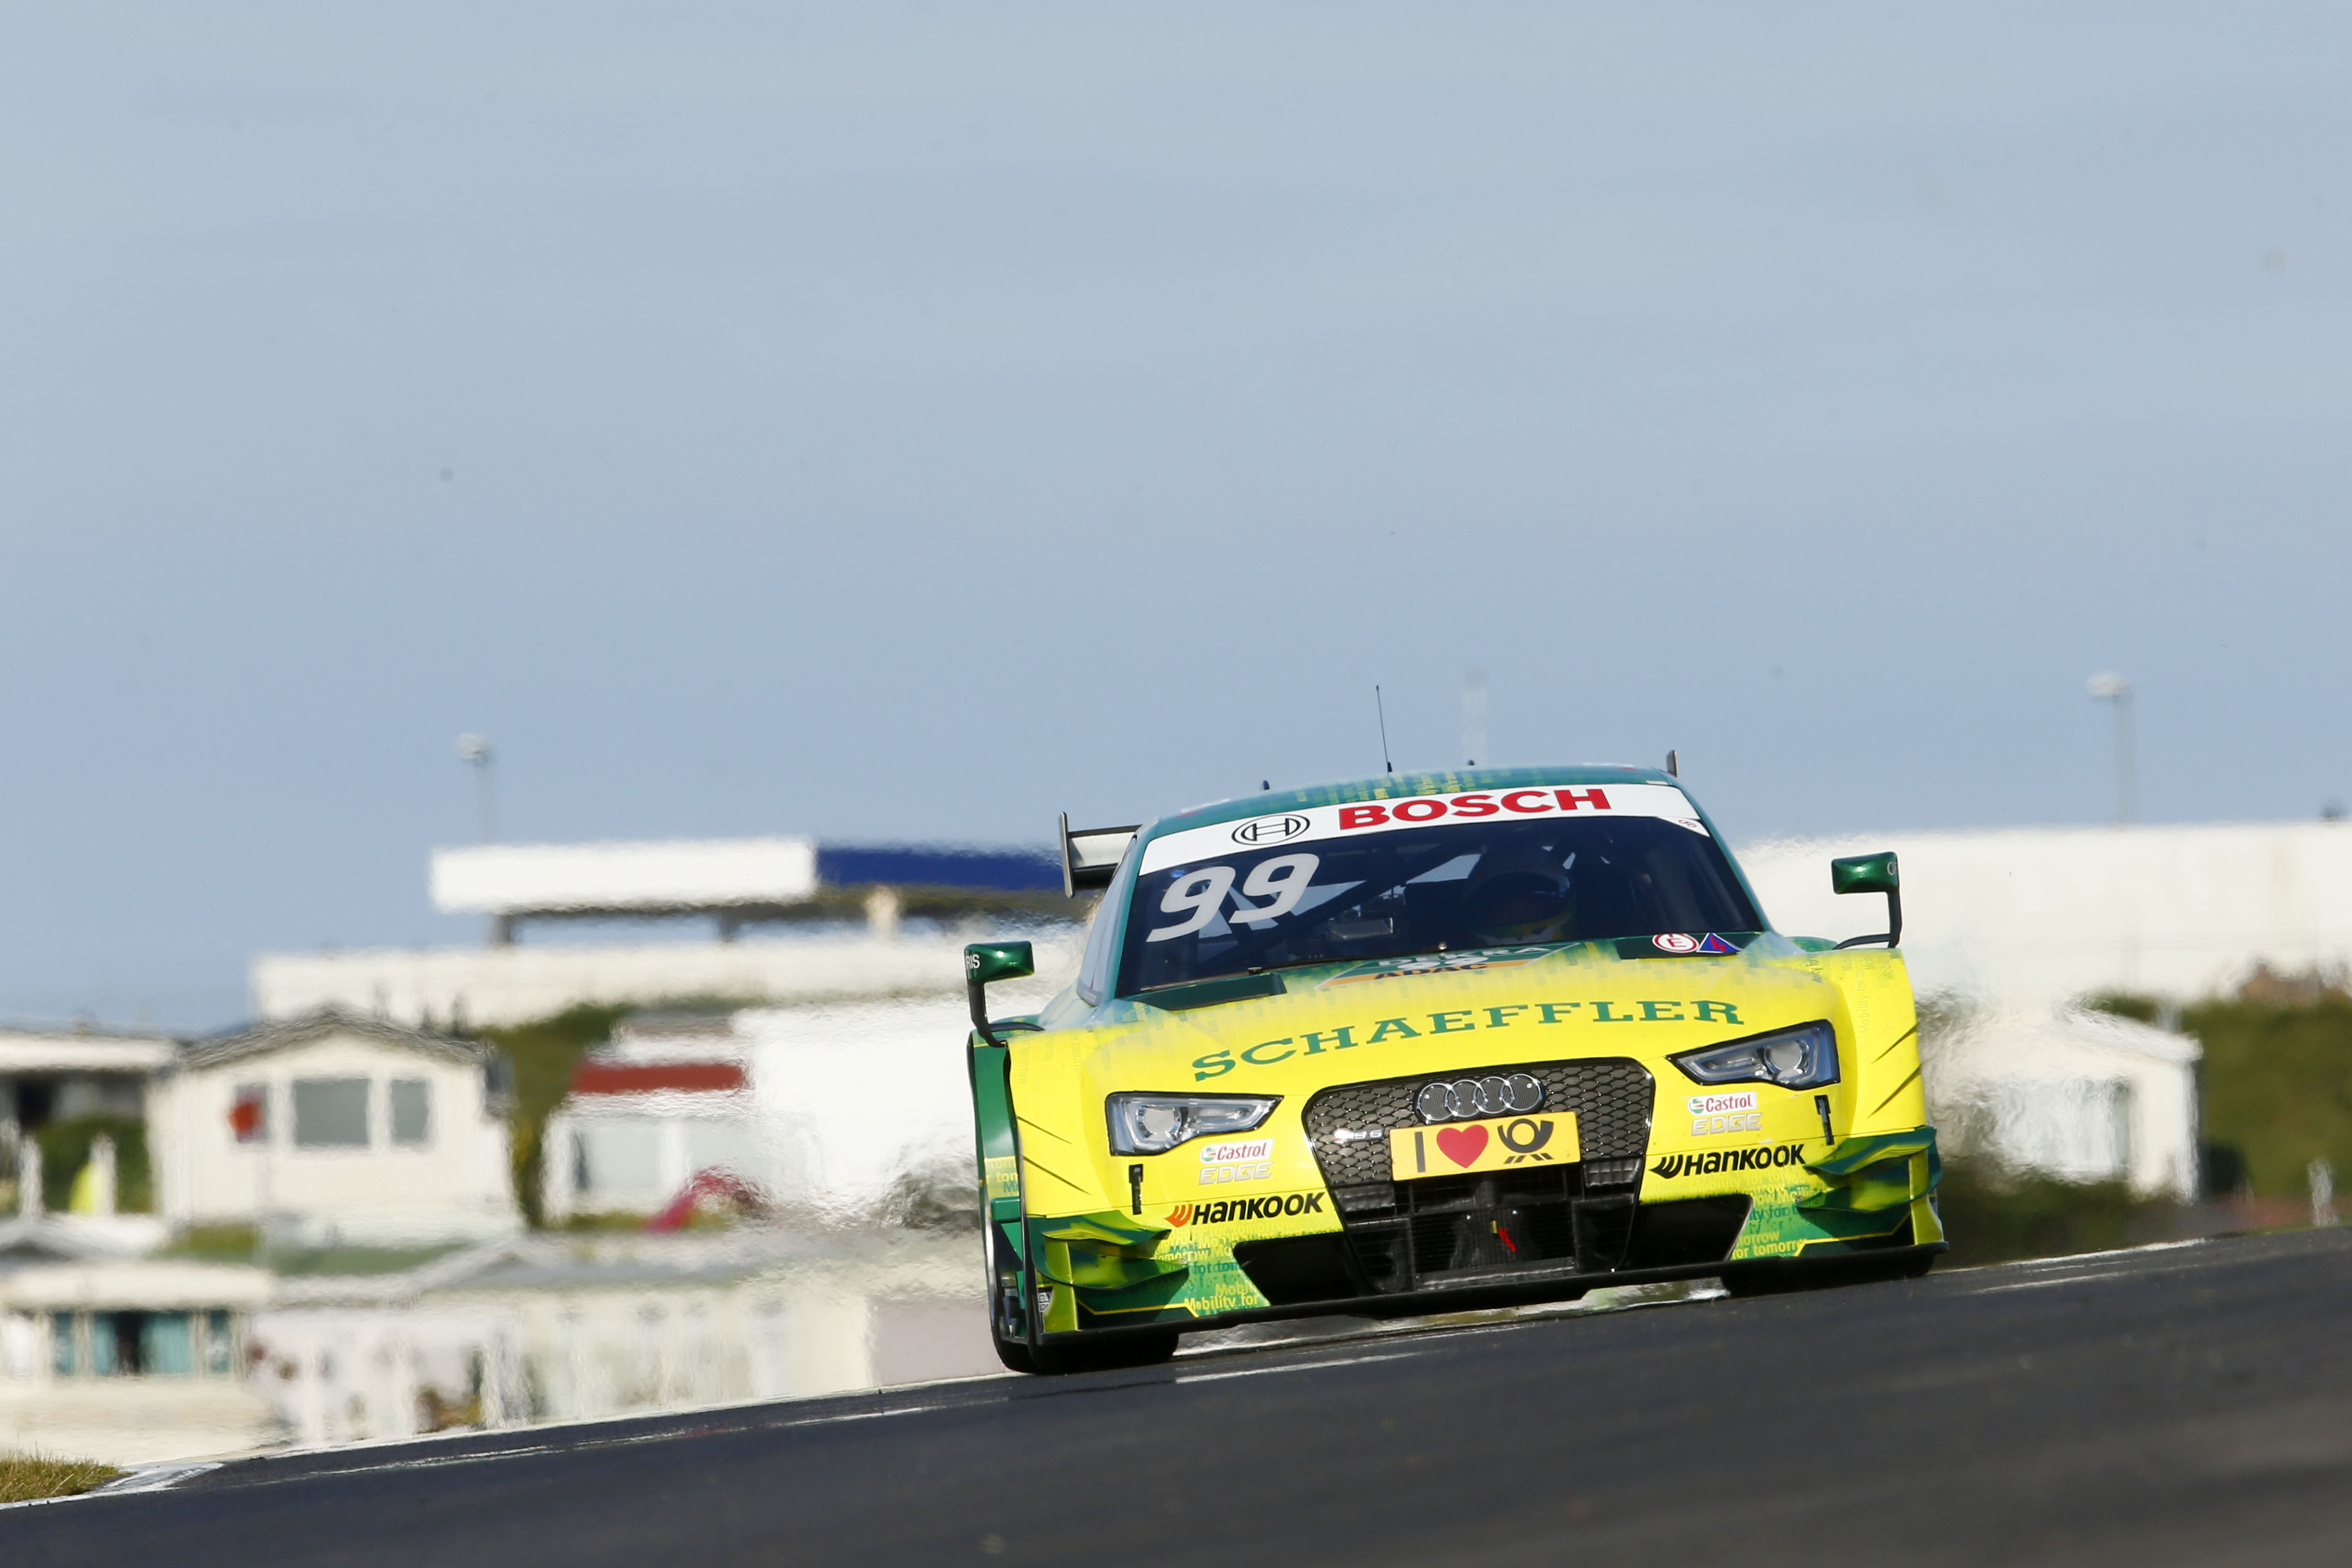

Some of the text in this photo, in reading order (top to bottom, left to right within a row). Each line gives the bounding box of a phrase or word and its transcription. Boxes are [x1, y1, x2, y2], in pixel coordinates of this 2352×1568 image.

[1338, 788, 1613, 830] BOSCH
[1146, 853, 1320, 942] 99
[1375, 963, 1488, 979] ADAC
[1191, 1000, 1745, 1082] SCHAEFFLER
[1705, 1095, 1753, 1113] Castrol
[1691, 1112, 1763, 1136] EDGE
[1217, 1142, 1267, 1160] Castrol
[1414, 1131, 1426, 1173] I
[1199, 1161, 1274, 1185] EDGE
[1184, 1292, 1259, 1310] Mobility for
